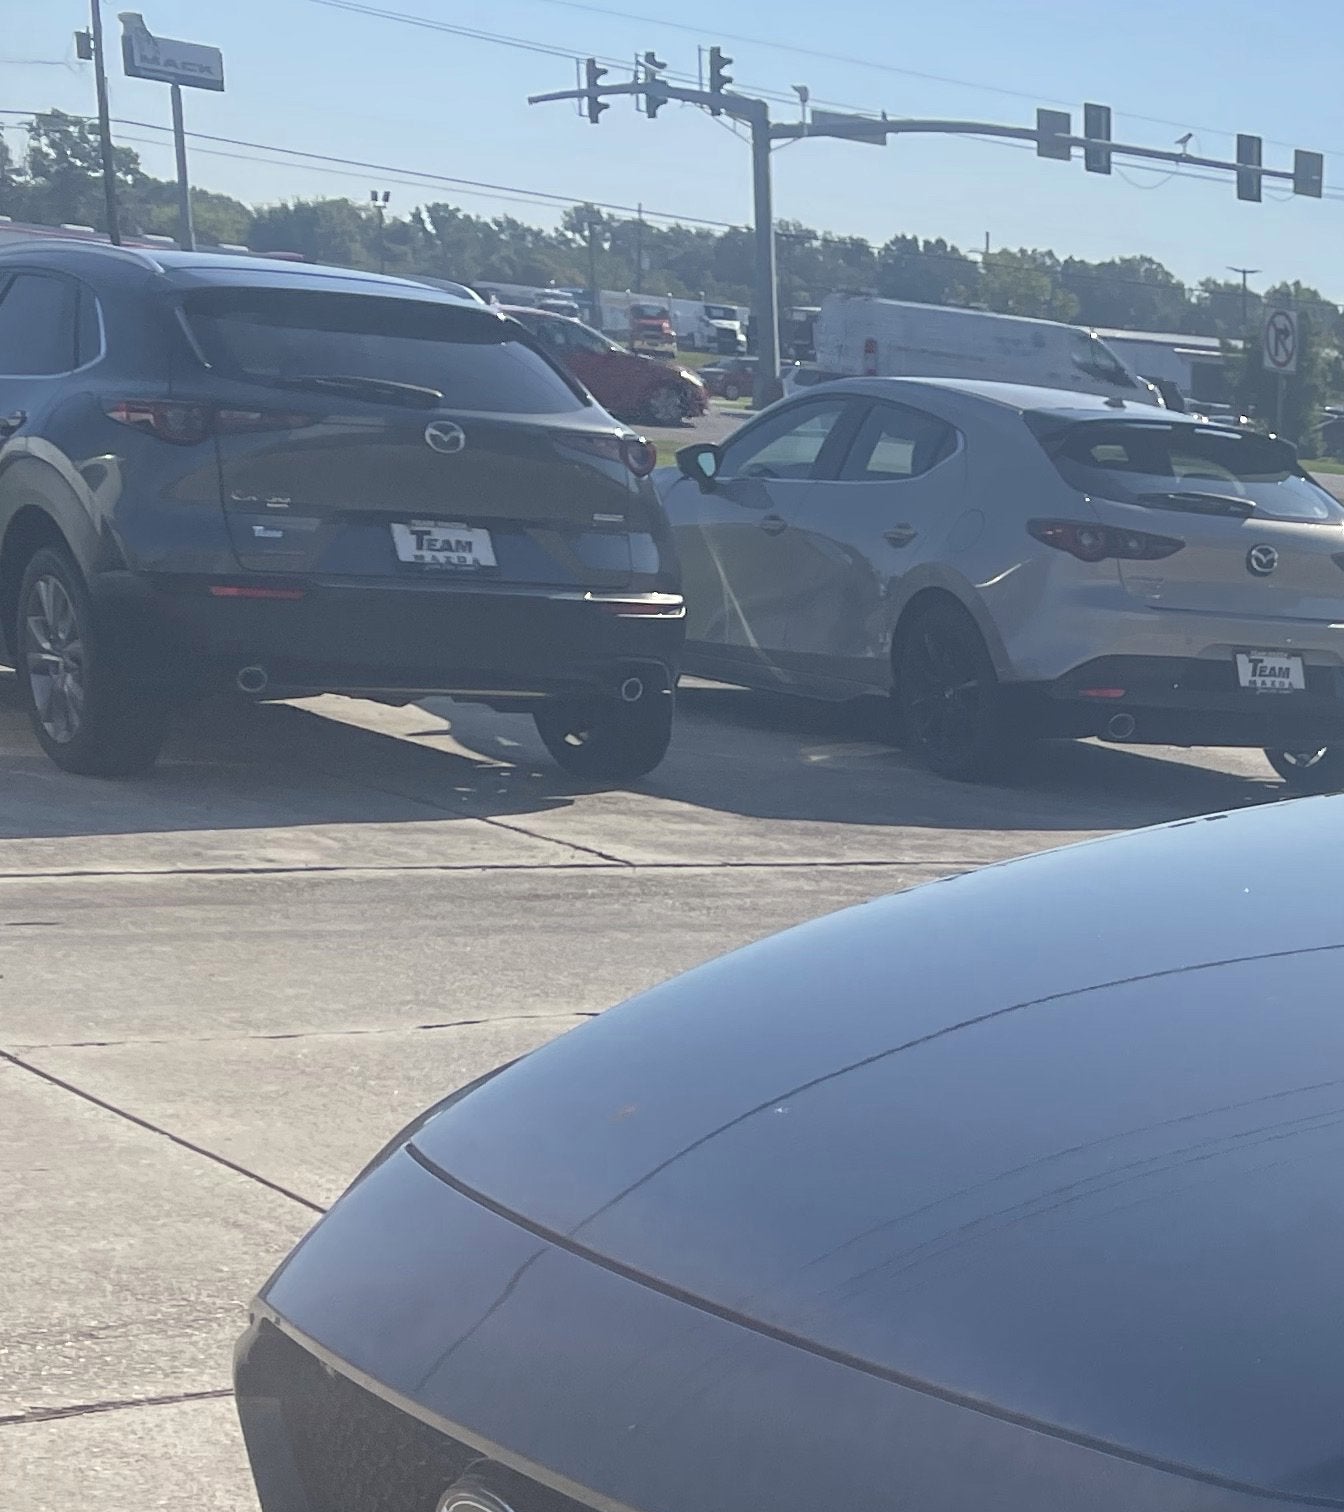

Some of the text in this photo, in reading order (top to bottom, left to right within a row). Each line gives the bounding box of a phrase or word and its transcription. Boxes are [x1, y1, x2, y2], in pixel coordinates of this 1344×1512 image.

[140, 54, 214, 75] MACK
[410, 529, 473, 553] TEAM
[1248, 658, 1291, 679] TEAM
